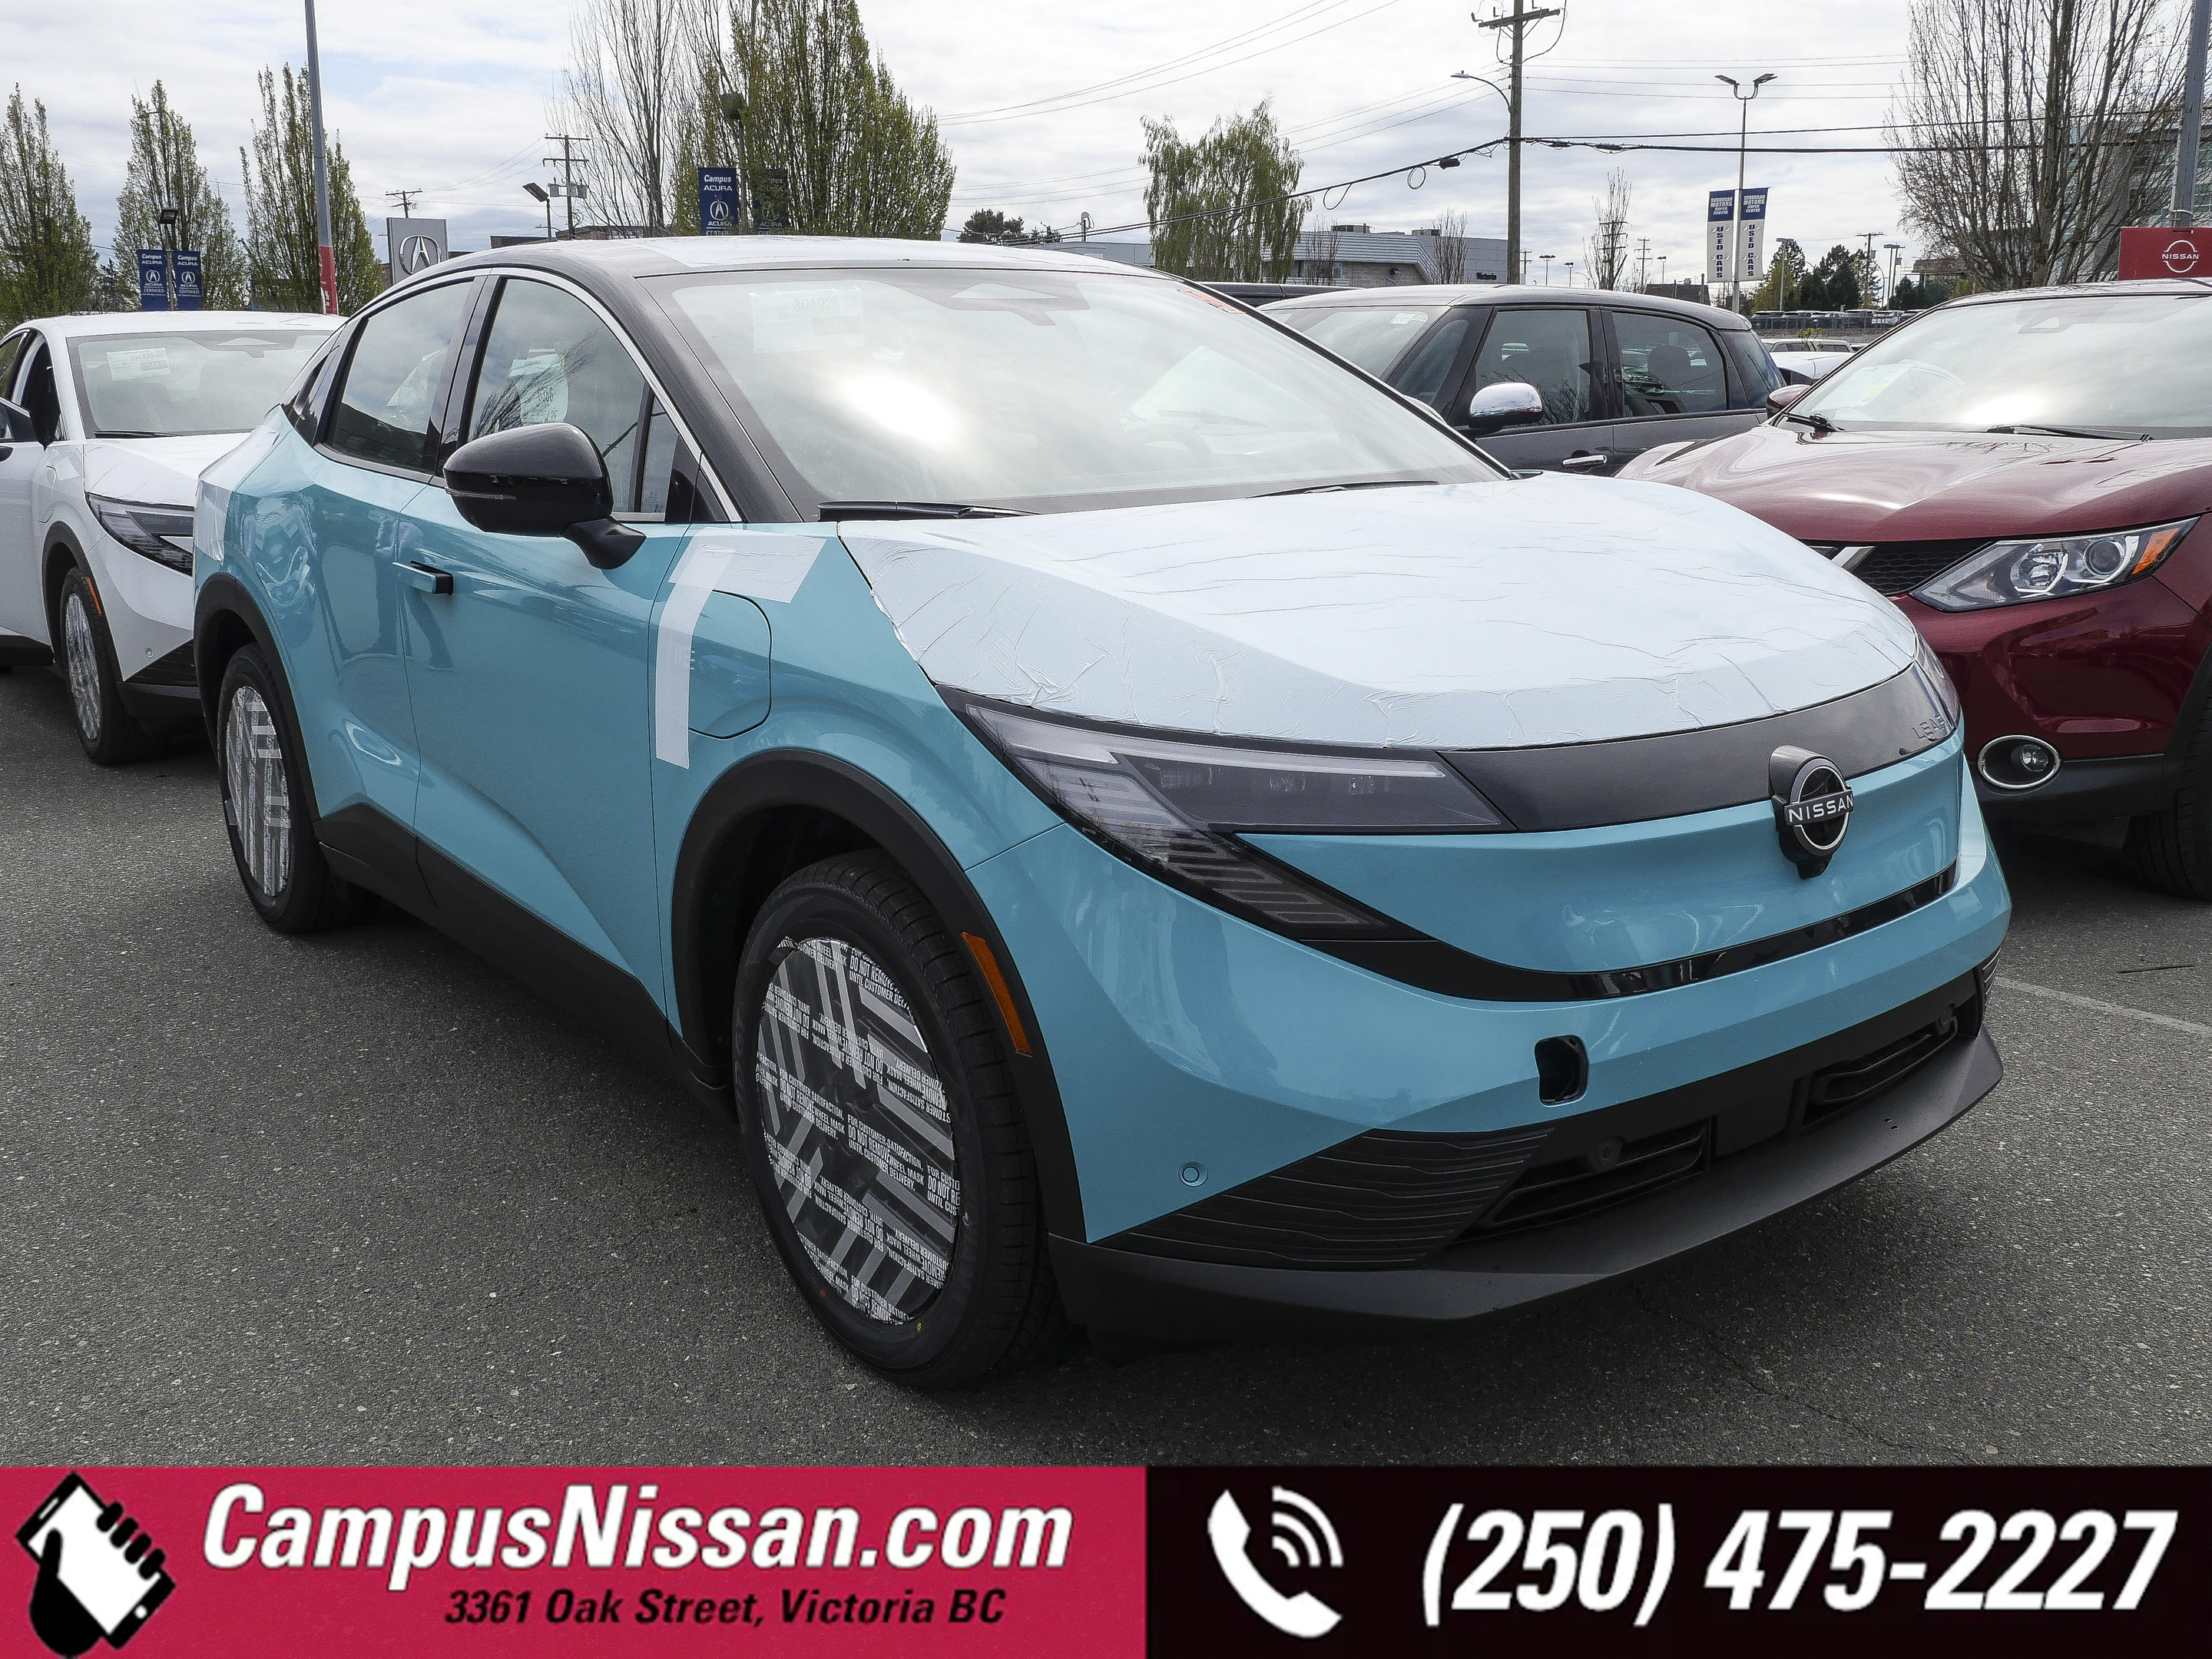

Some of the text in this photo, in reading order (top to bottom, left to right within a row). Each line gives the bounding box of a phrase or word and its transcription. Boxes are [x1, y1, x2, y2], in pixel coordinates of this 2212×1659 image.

[704, 174, 732, 184] Campus
[793, 296, 840, 312] 304925
[1788, 795, 1854, 823] NISSAN
[849, 955, 859, 972] DO
[859, 959, 870, 977] NOT
[849, 970, 864, 988] UNTIL
[864, 979, 893, 1002] CUSTOMER
[812, 1091, 845, 1121] SATISFACTION,
[886, 1078, 926, 1111] SATISFACTION,
[847, 1114, 924, 1172] FOR CUSTOMER SATISFACTION,
[848, 1124, 925, 1186] DO NOT REMOVE WHEEL MASK
[848, 1138, 916, 1191] UNTIL CUSTOMER DELIVERY.
[927, 1165, 939, 1179] FOR
[927, 1190, 944, 1208] UNTIL
[928, 1175, 936, 1190] DO
[937, 1181, 949, 1199] NOT
[814, 1193, 846, 1225] SATISFACTION,
[820, 1175, 883, 1227] UNTIL CUSTOMER DELIVERY.
[864, 1217, 875, 1236] NOT
[876, 1225, 883, 1243] DO
[873, 1237, 883, 1252] FOR
[886, 1232, 902, 1250] MASK
[893, 1227, 919, 1253] DELIVERY.
[887, 1245, 925, 1280] SATISFACTION,
[902, 1243, 922, 1264] WHEEL
[851, 1274, 860, 1289] FOR
[861, 1283, 888, 1310] CUSTOMER
